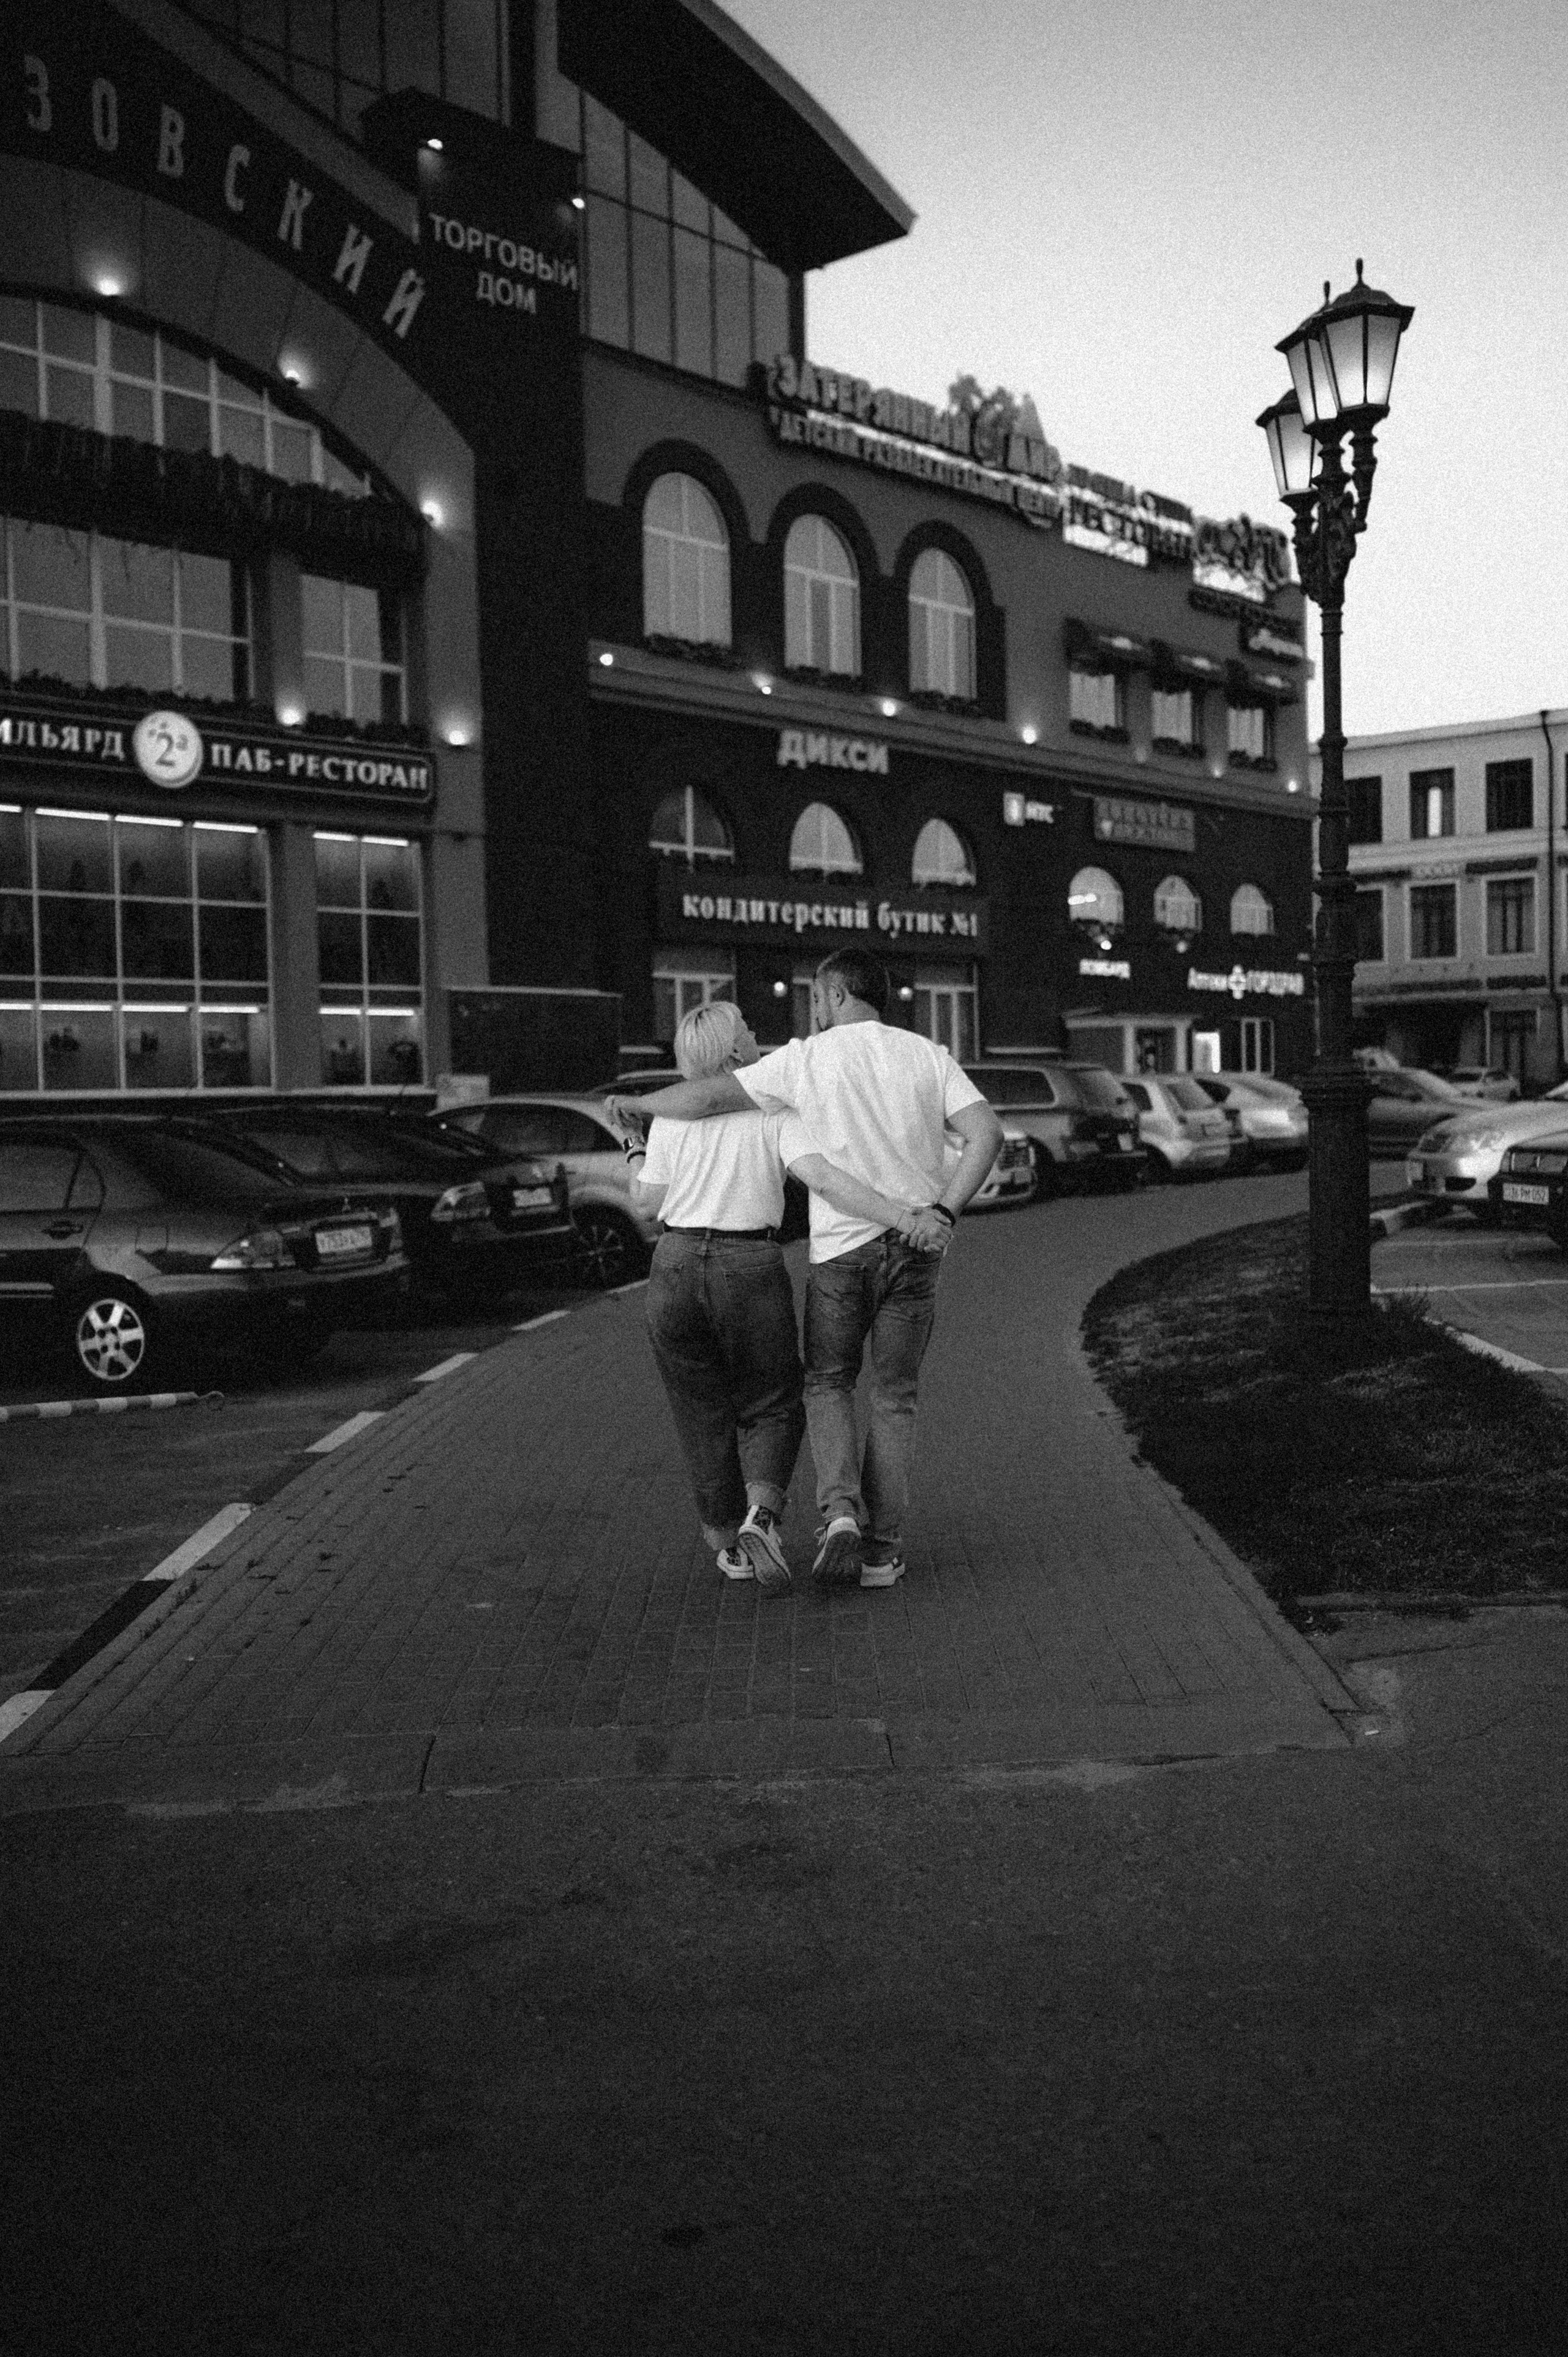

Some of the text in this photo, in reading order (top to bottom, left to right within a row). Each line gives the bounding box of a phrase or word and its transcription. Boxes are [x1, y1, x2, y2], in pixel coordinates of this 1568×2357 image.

[23, 53, 426, 339] ЗОВСКИЙ
[429, 213, 578, 291] ТОРГОВЫЙ
[476, 271, 537, 315] ДОМ
[211, 742, 428, 791] ПАБ-РЕСТОРАН
[777, 729, 889, 775] ДИКСИ
[682, 894, 870, 933] кондитерский
[878, 901, 945, 939] бутик
